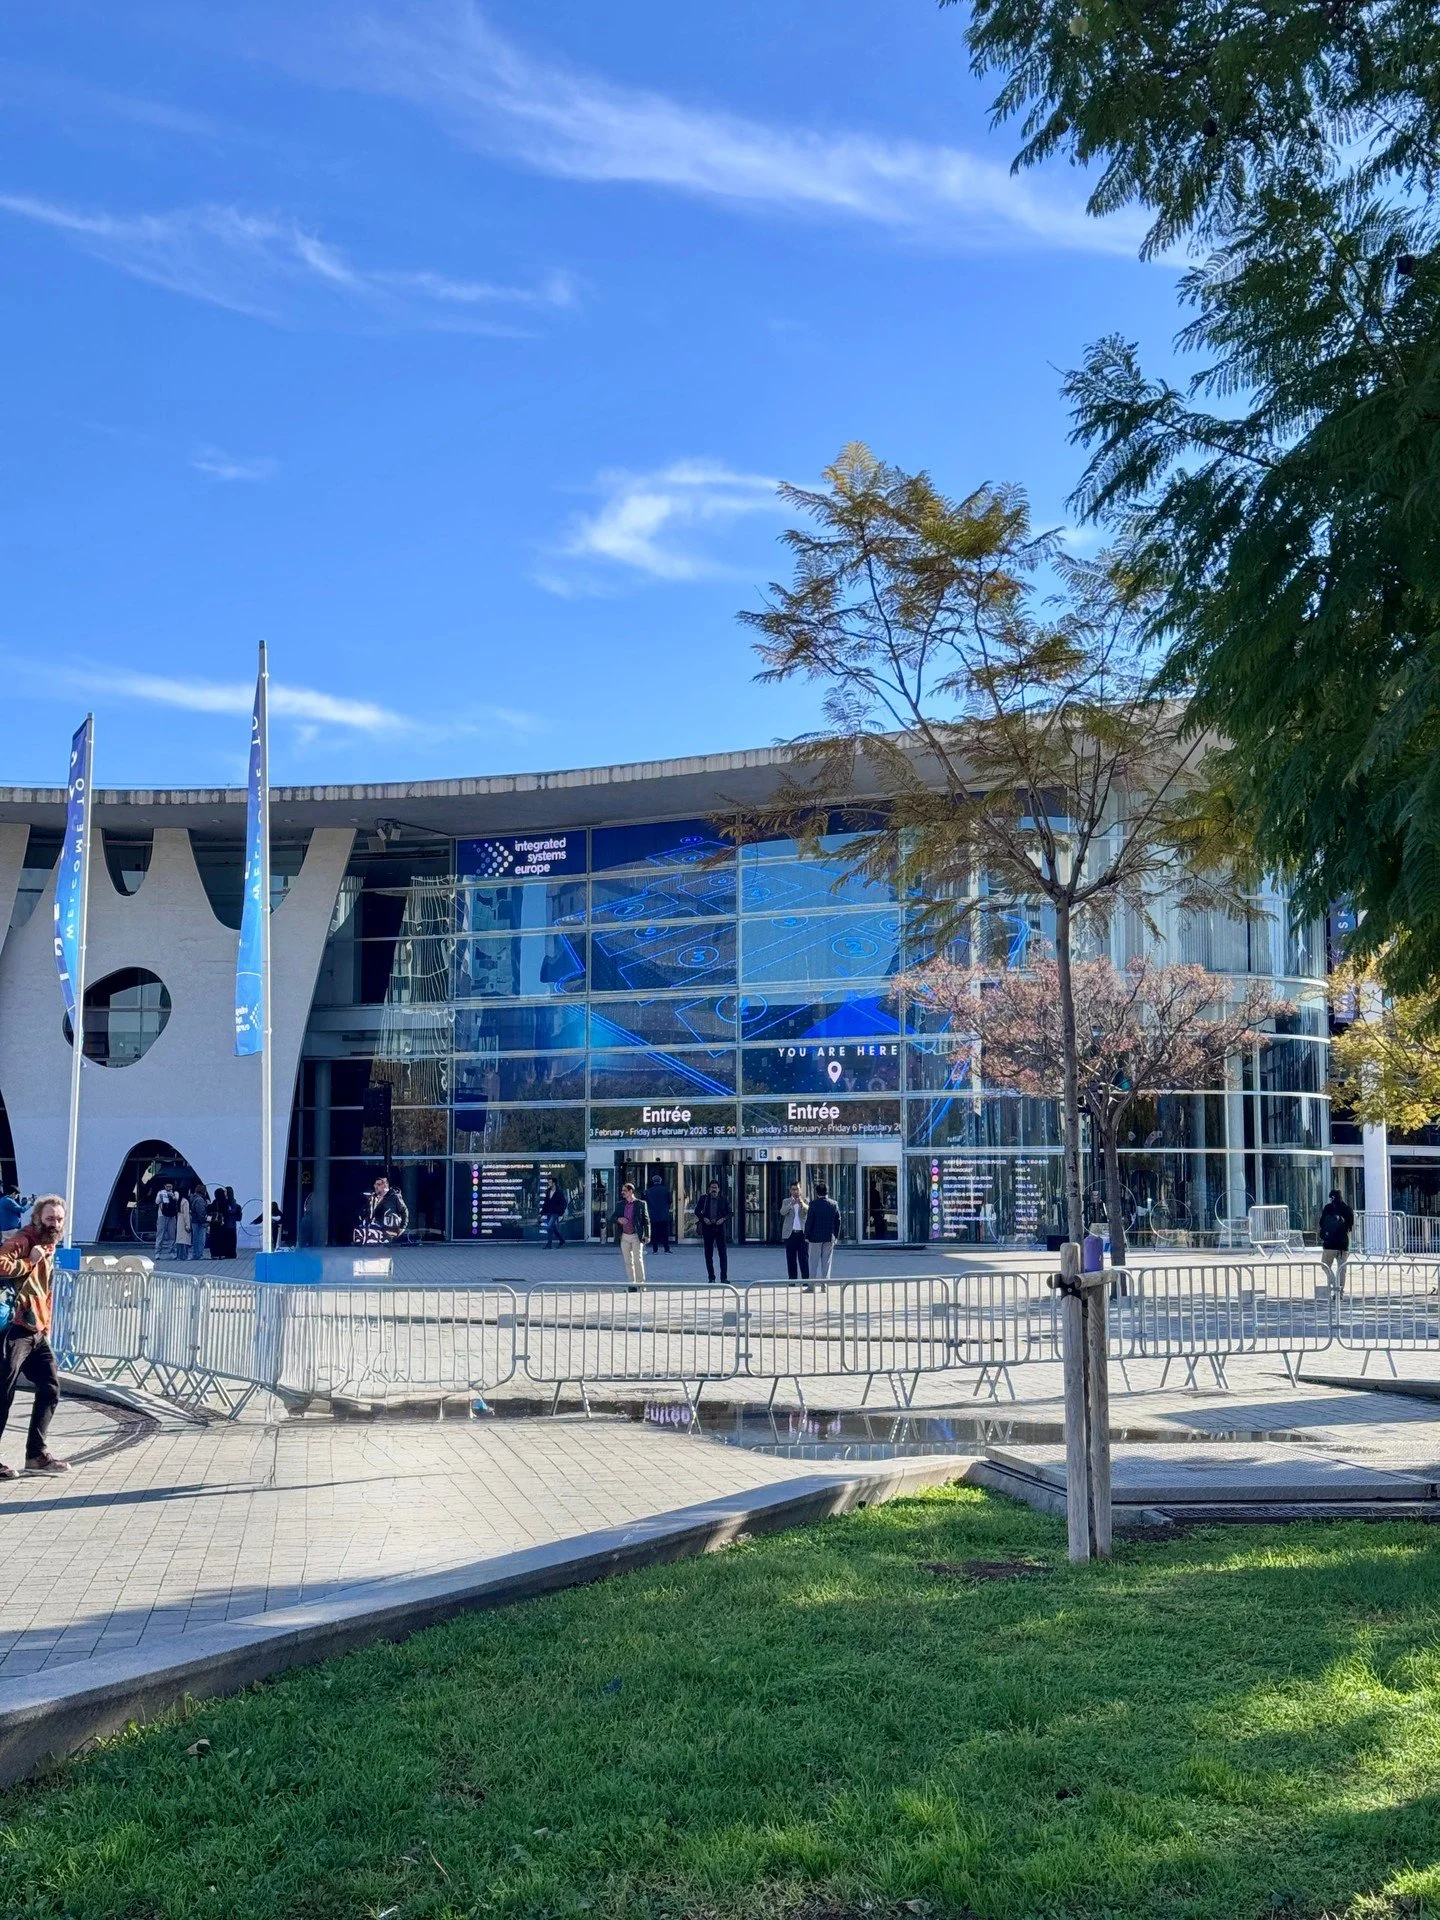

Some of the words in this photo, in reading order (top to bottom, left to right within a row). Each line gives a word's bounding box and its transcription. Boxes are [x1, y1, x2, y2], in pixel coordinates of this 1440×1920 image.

[514, 837, 566, 852] integrated
[527, 850, 567, 863] systems
[514, 863, 550, 875] europe
[844, 941, 865, 954] 2
[690, 950, 705, 963] 3
[777, 1047, 807, 1058] YOU
[817, 1046, 846, 1057] ARE
[857, 1045, 898, 1057] HERE
[642, 1106, 692, 1123] Entrée
[787, 1102, 840, 1120] Entrée
[595, 1128, 624, 1138] February
[629, 1127, 651, 1137] Friday
[657, 1126, 689, 1137] February
[689, 1126, 708, 1135] 2026
[713, 1126, 725, 1134] ISE
[750, 1124, 781, 1135] Tuesday
[789, 1123, 823, 1134] February
[828, 1122, 850, 1134] Friday
[858, 1122, 893, 1134] February
